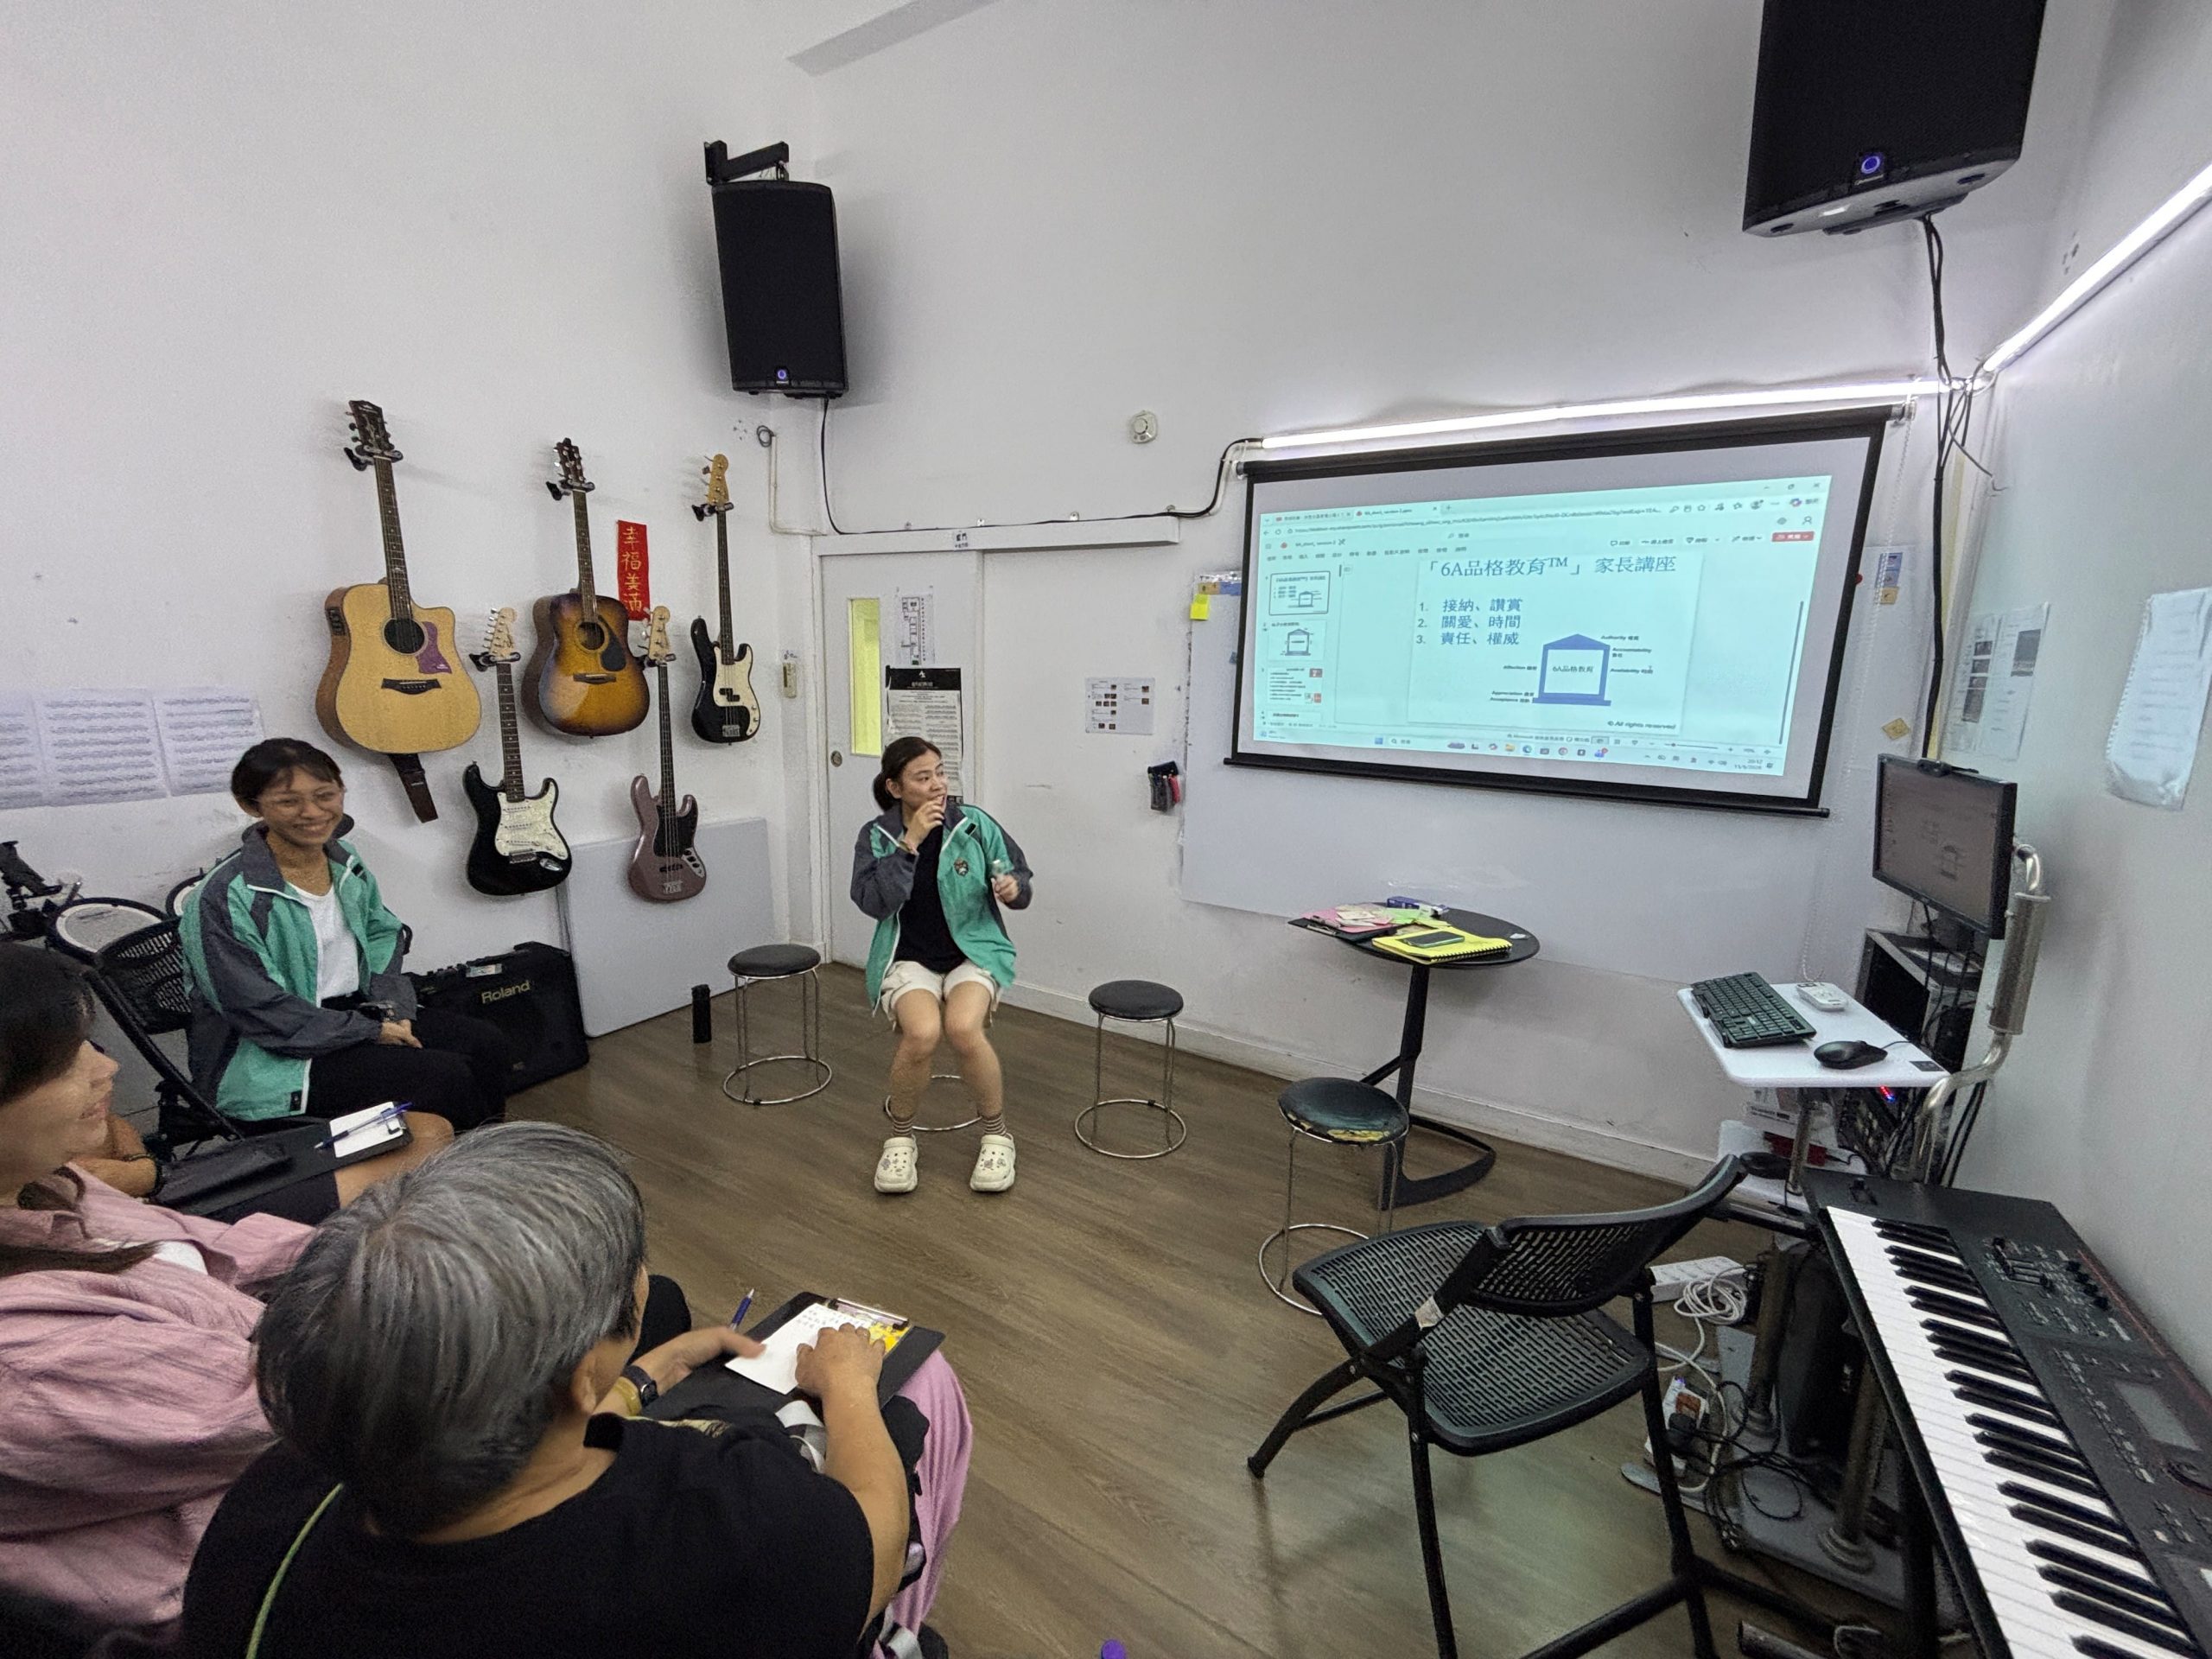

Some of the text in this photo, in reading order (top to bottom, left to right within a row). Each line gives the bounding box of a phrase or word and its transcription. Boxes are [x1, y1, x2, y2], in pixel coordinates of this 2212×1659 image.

[1594, 556, 1677, 574] 家長講座
[1440, 615, 1521, 629] 關愛、時間
[1440, 632, 1520, 645] 責任、權威
[481, 980, 531, 1004] Roland
